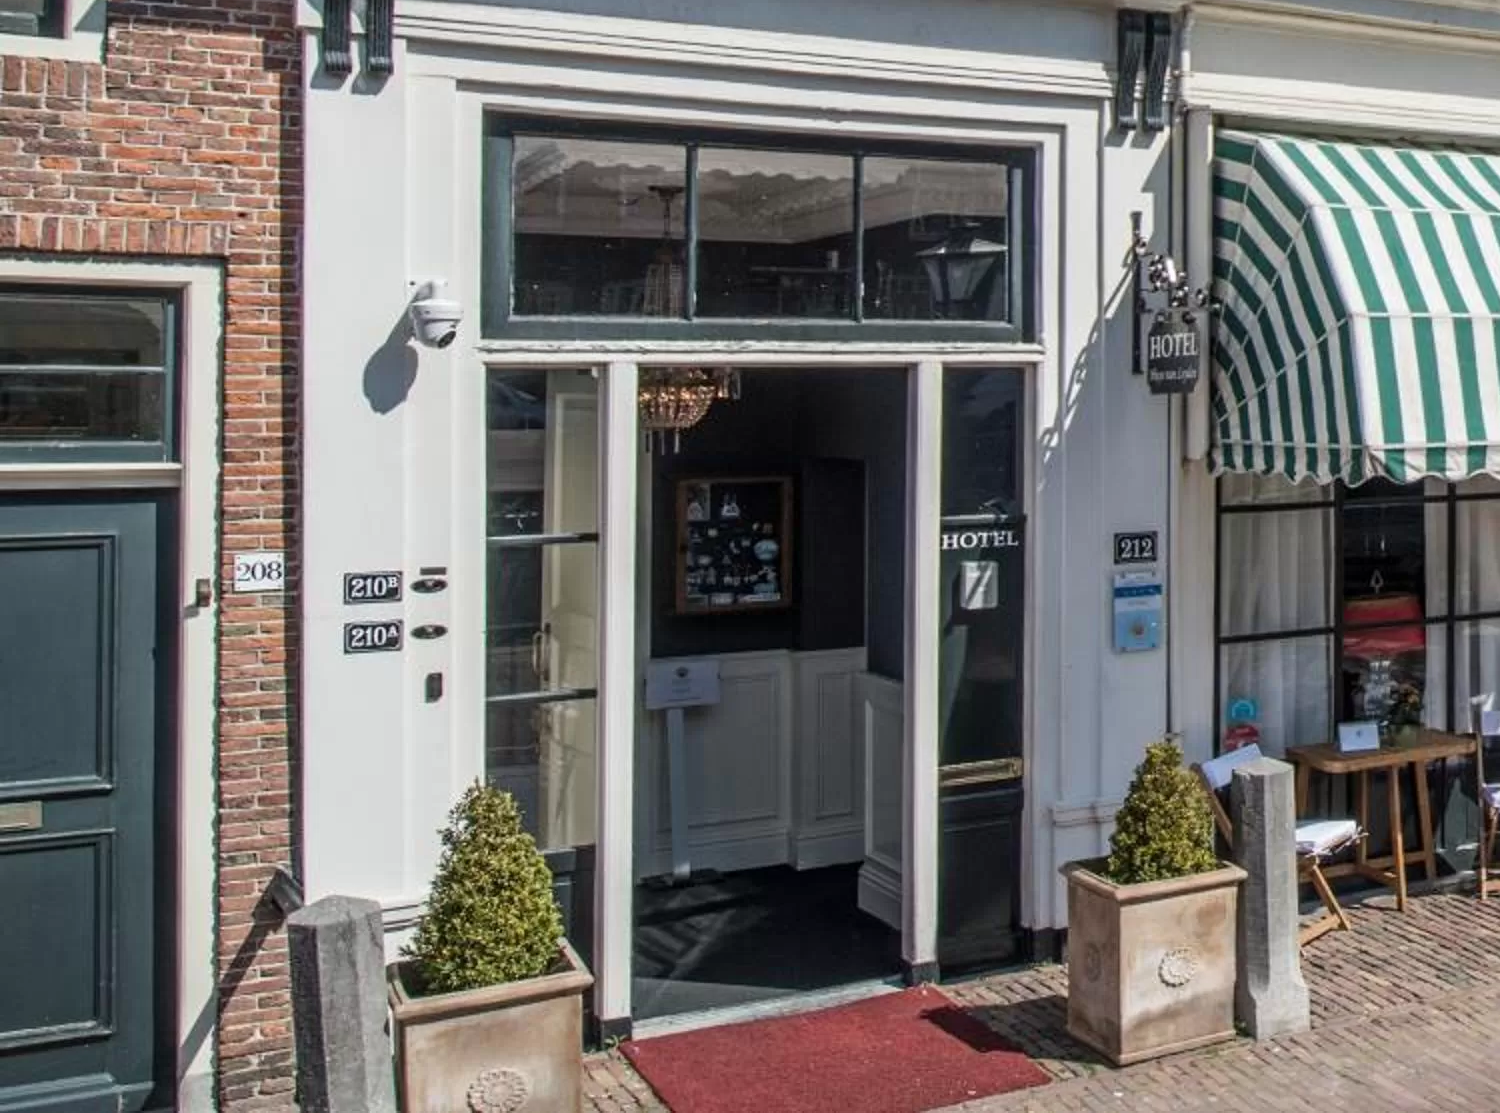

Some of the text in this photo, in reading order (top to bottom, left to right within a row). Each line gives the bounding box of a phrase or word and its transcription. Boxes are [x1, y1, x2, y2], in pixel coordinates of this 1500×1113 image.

[1149, 332, 1198, 360] HOTEL
[941, 530, 1019, 550] HOTEL
[1120, 538, 1153, 558] 212
[237, 561, 282, 582] 208
[351, 577, 398, 598] 210B
[351, 625, 398, 647] 210A
